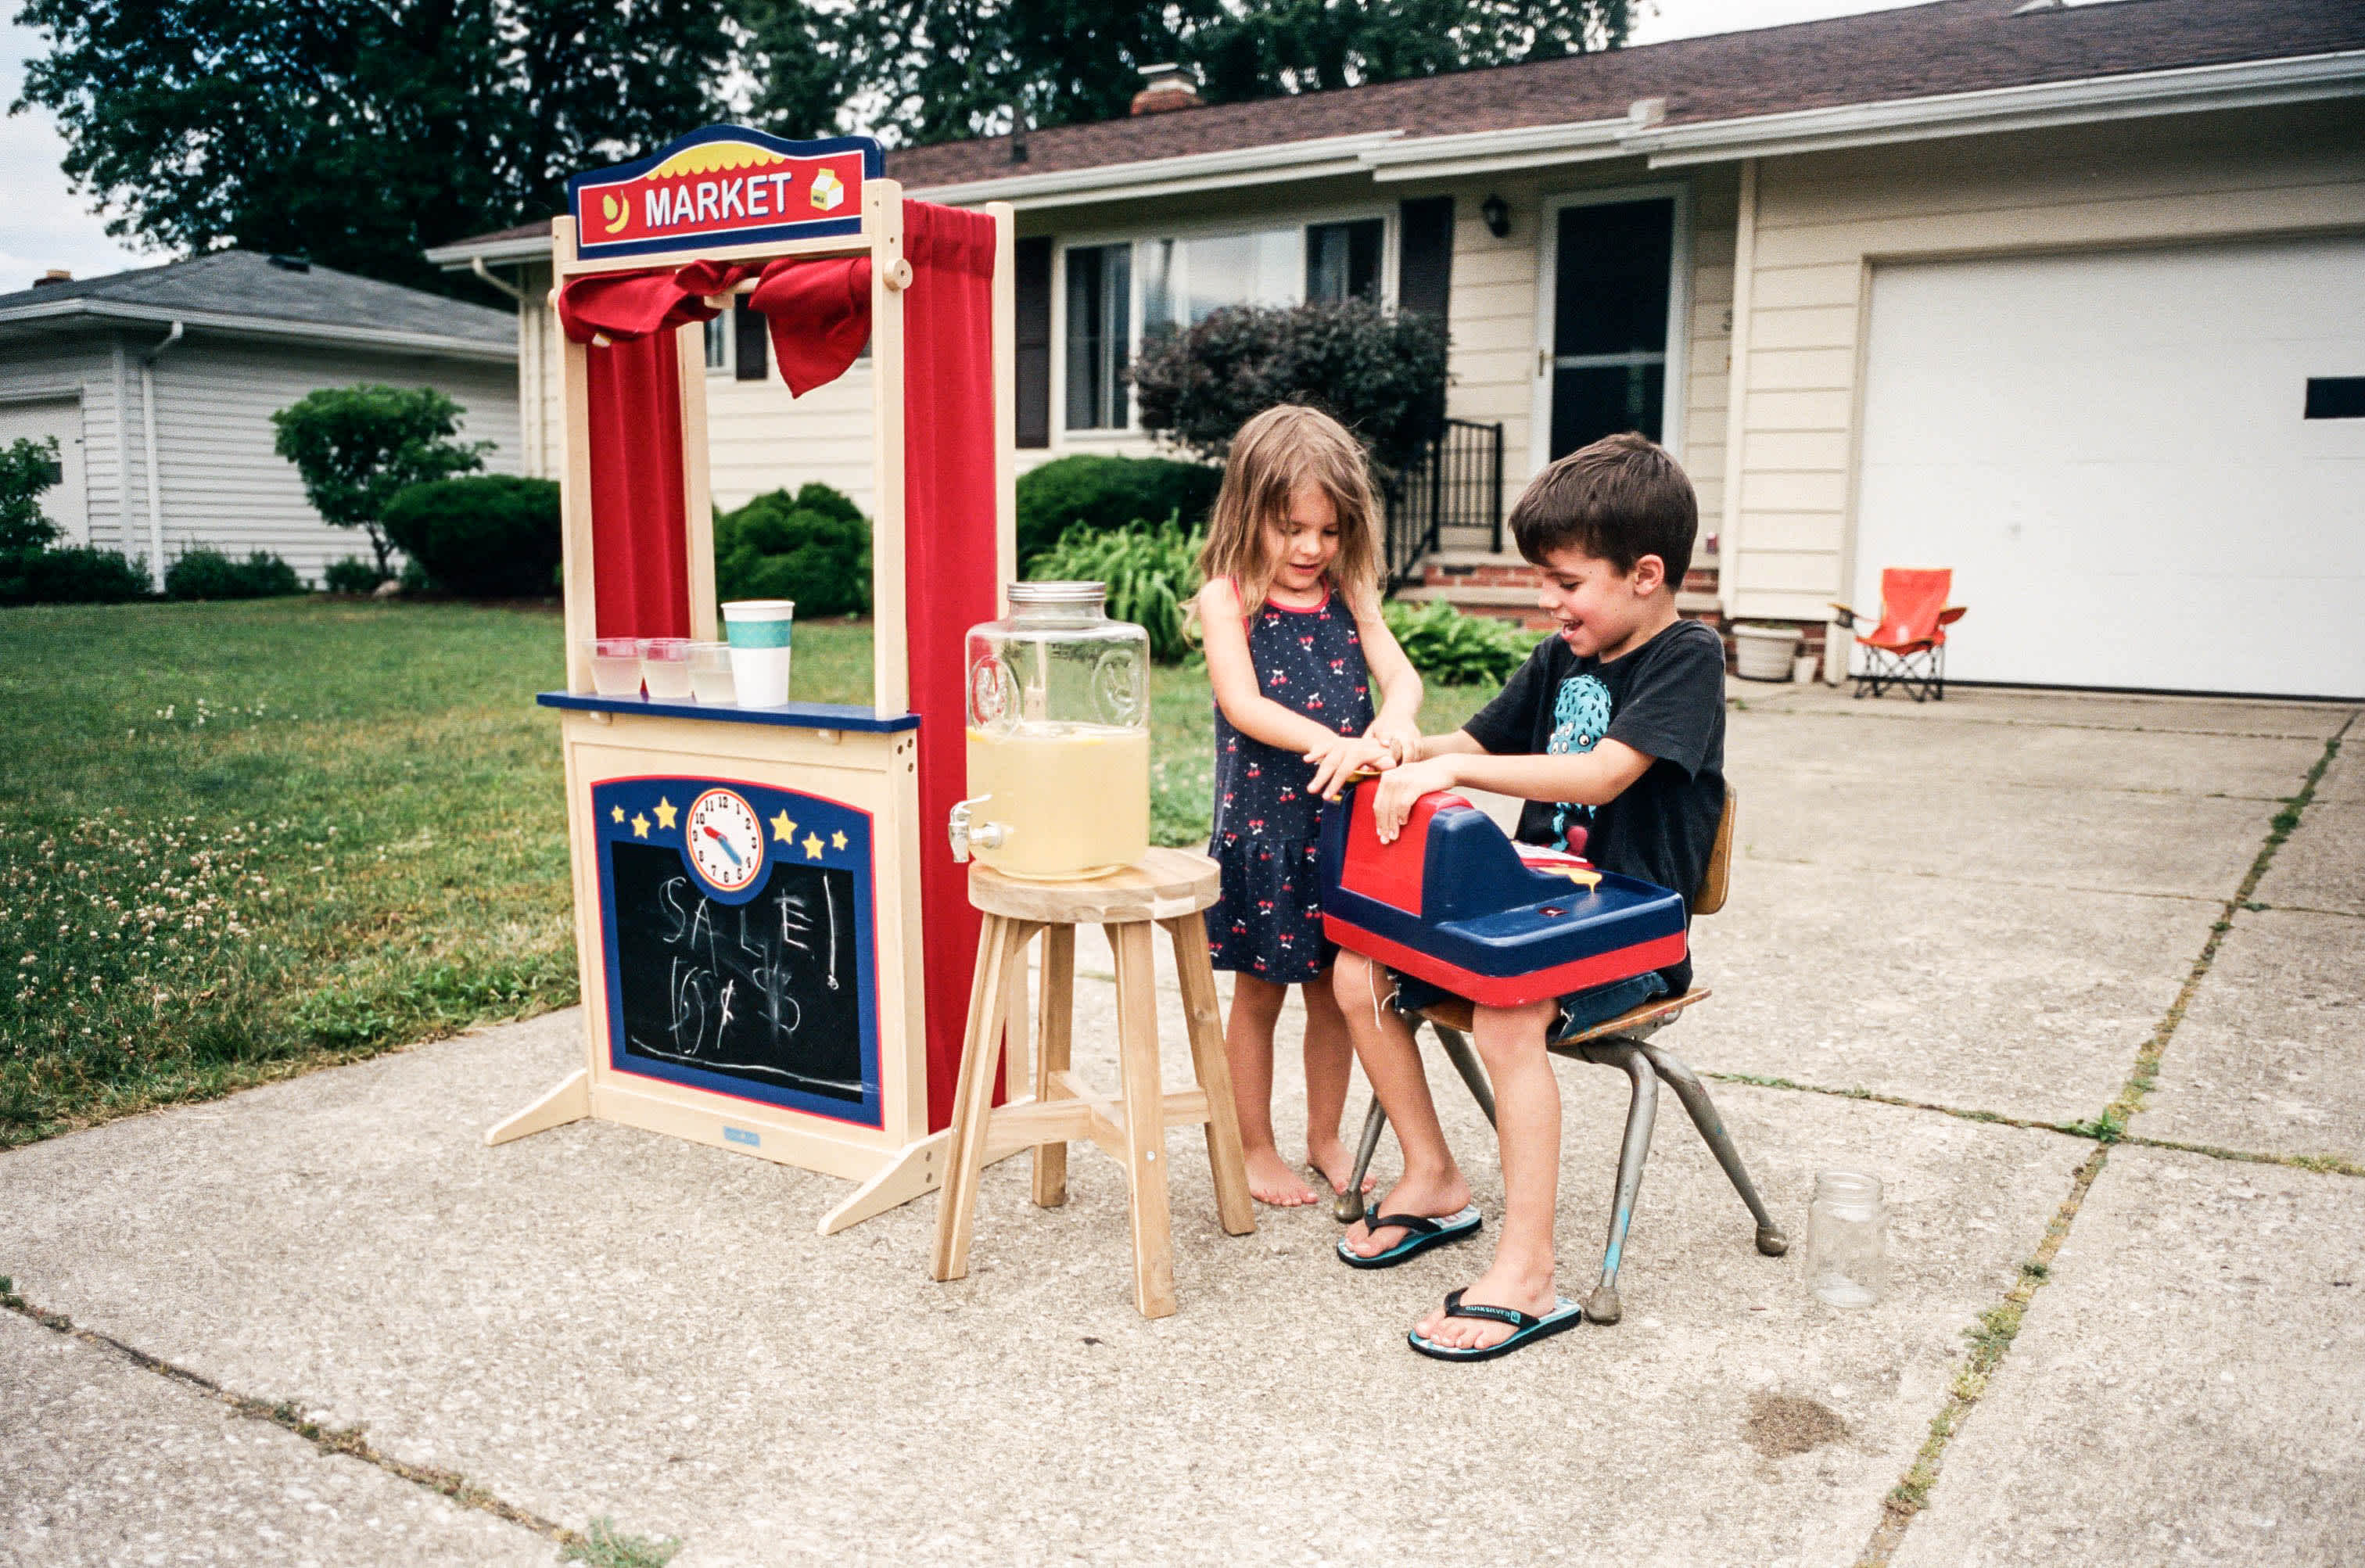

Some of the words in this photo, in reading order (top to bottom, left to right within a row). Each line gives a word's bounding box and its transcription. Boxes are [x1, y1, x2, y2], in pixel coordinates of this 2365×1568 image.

[645, 171, 792, 228] MARKET
[705, 799, 714, 812] 11
[718, 795, 728, 809] 12
[736, 802, 741, 815] 1
[695, 812, 705, 825] 10
[745, 817, 751, 830] 2
[692, 829, 698, 842] 9
[752, 836, 757, 849] 3
[745, 856, 752, 869] 4
[711, 863, 716, 877] 7
[723, 870, 729, 883] 6
[737, 867, 742, 881] 5
